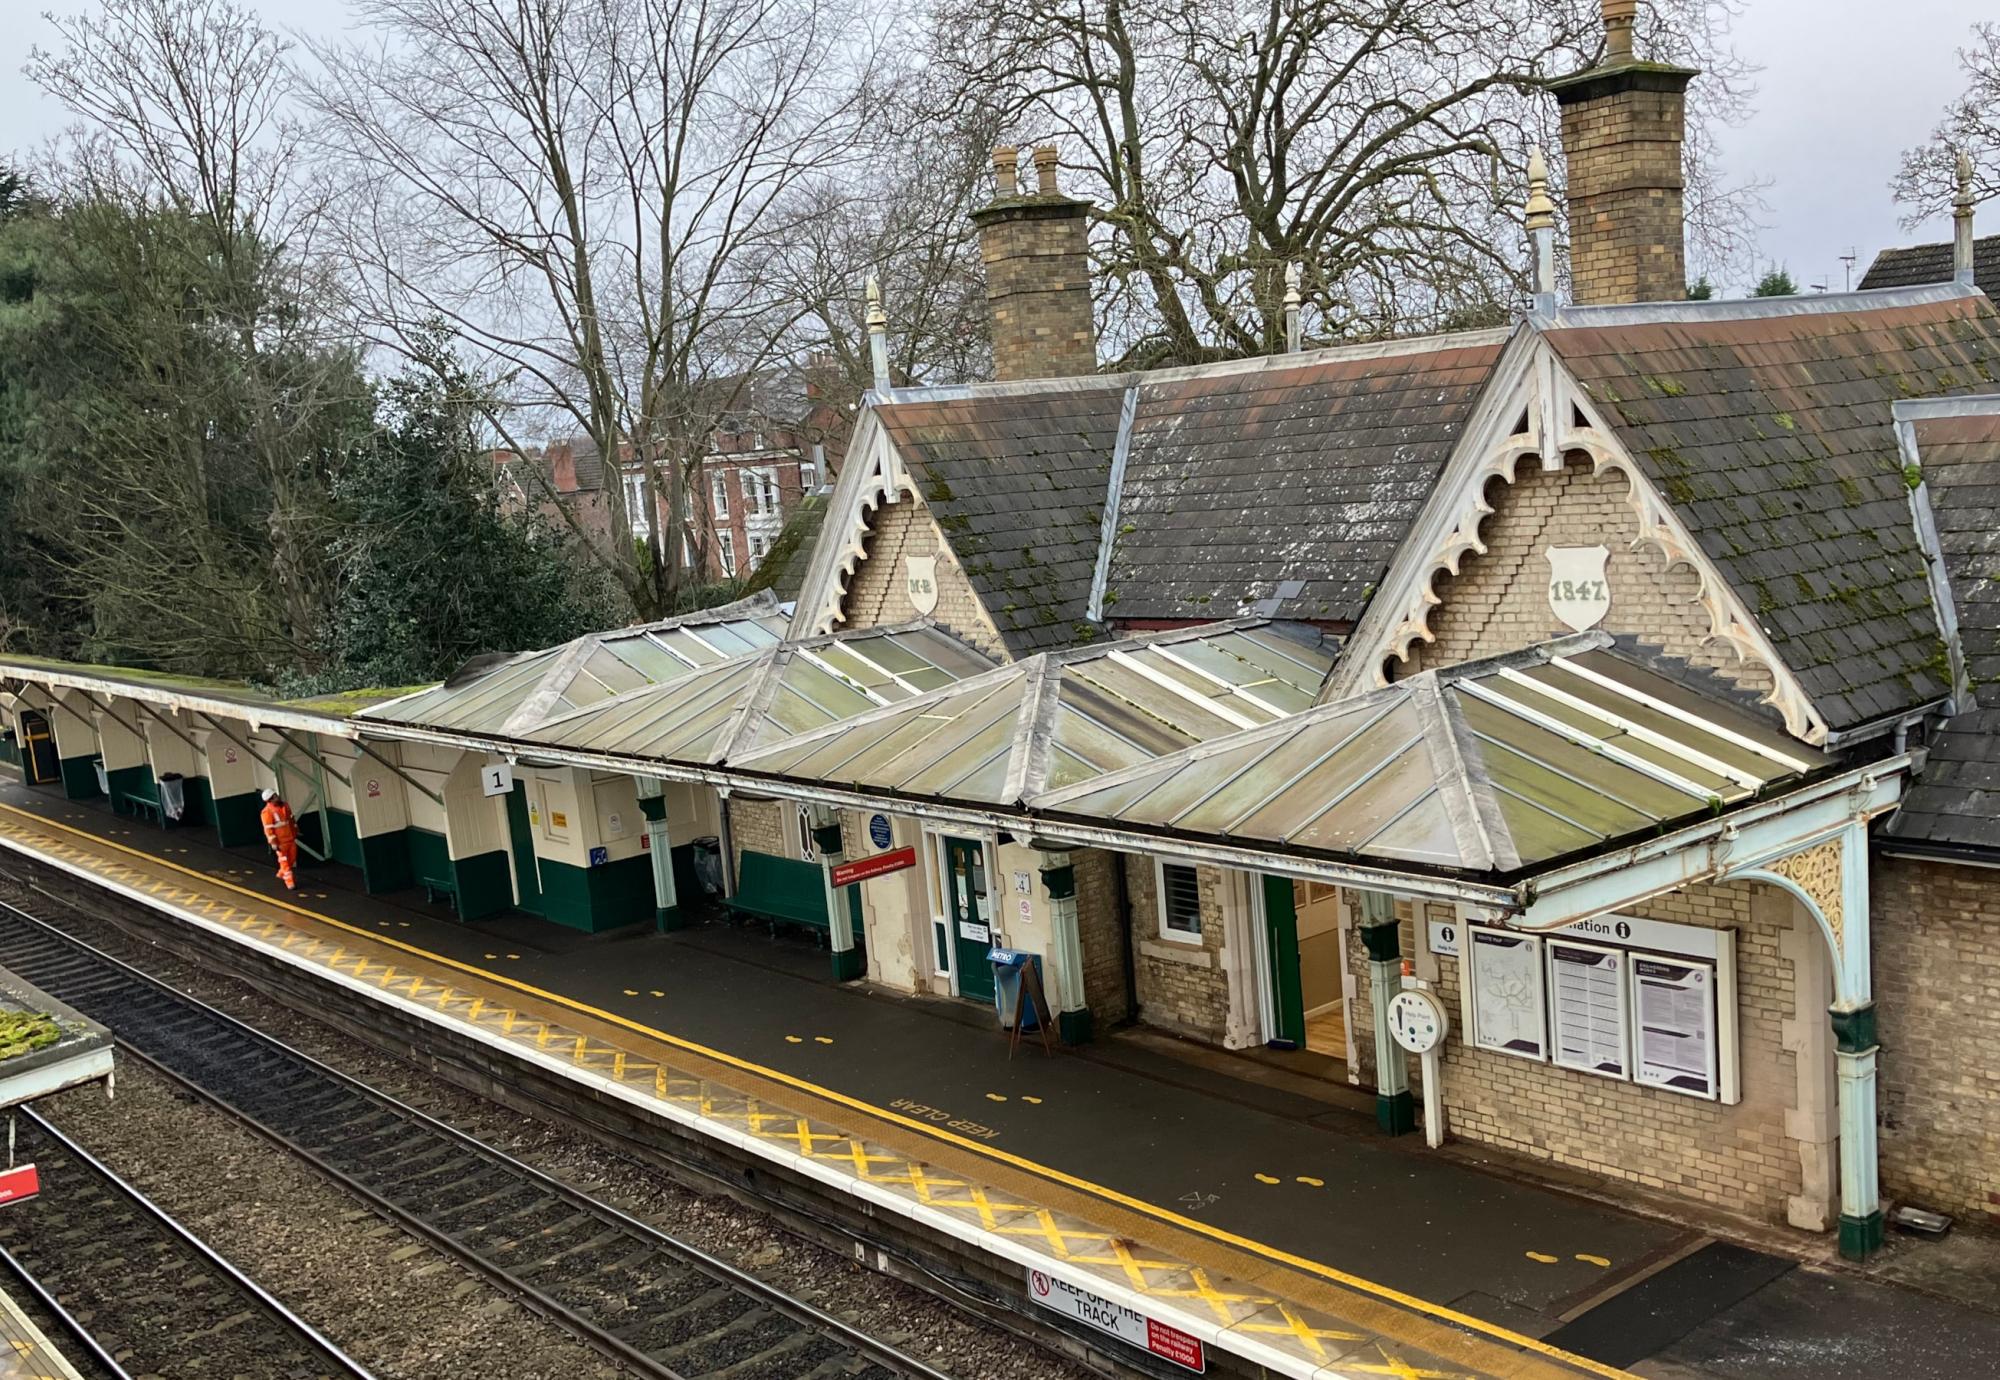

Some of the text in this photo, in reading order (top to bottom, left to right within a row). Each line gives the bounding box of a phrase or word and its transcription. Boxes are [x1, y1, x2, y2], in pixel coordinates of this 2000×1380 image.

[1551, 580, 1607, 601] 1847
[491, 771, 504, 788] 1
[991, 951, 1012, 961] METRO
[889, 1098, 1000, 1139] KEEP CLEAR
[1075, 1298, 1120, 1331] TRACK
